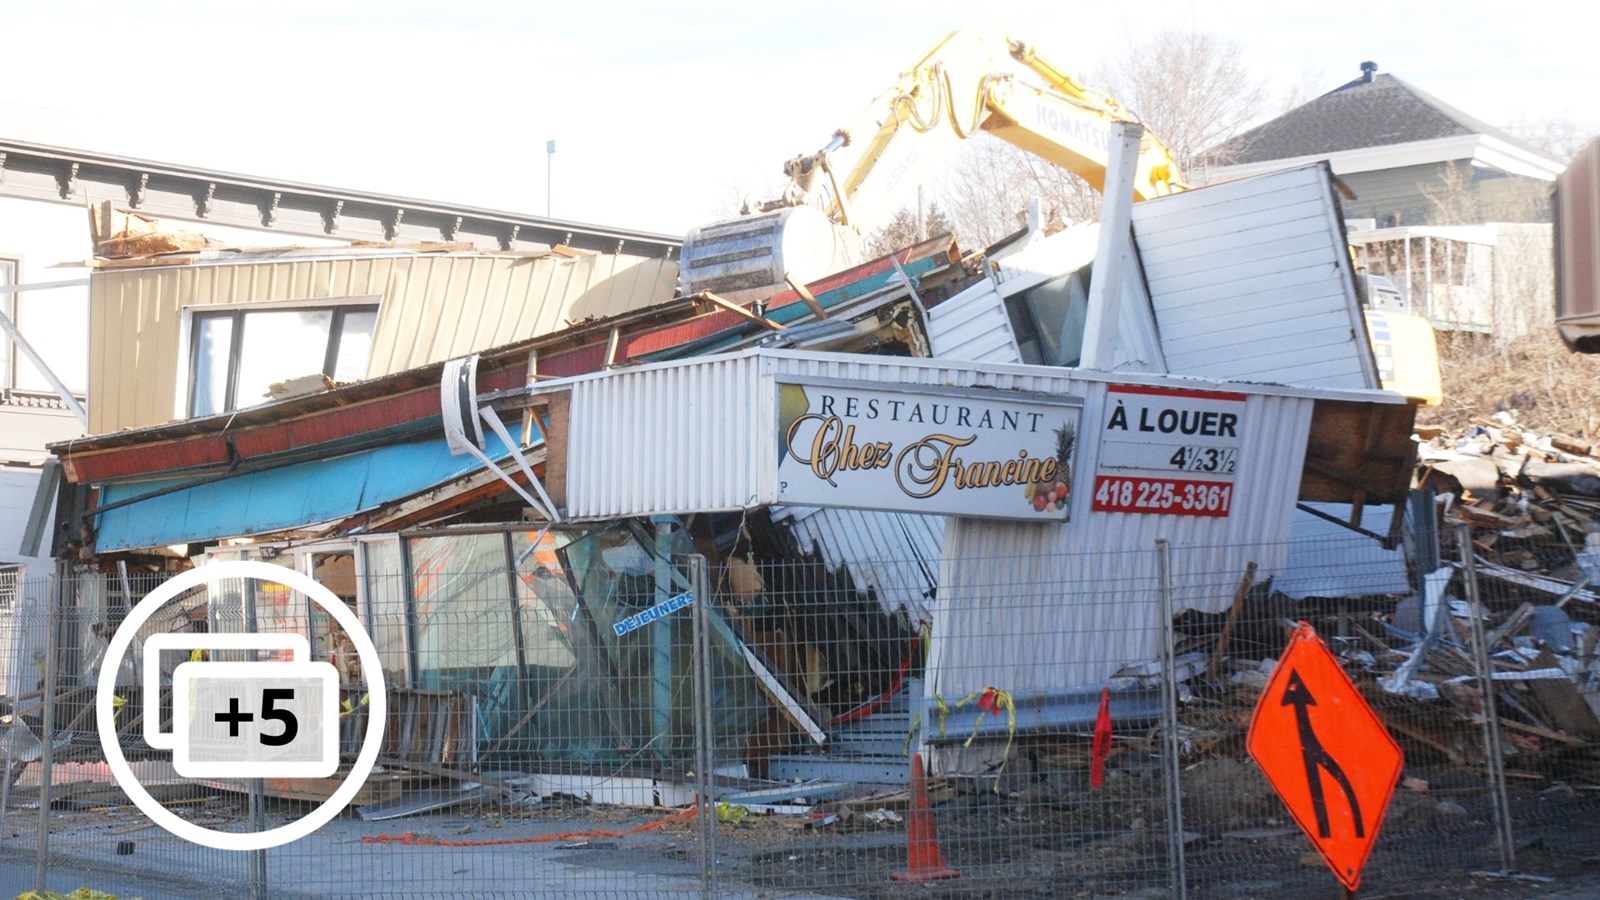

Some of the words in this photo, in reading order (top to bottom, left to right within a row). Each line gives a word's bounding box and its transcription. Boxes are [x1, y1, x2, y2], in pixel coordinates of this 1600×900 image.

[820, 394, 1044, 433] RESTAURANT
[1107, 399, 1128, 431] À
[1138, 407, 1238, 437] LOUER
[786, 412, 893, 488] Chez
[894, 433, 1058, 499] Francine
[1095, 479, 1134, 507] 418
[1135, 481, 1232, 511] 225-3361
